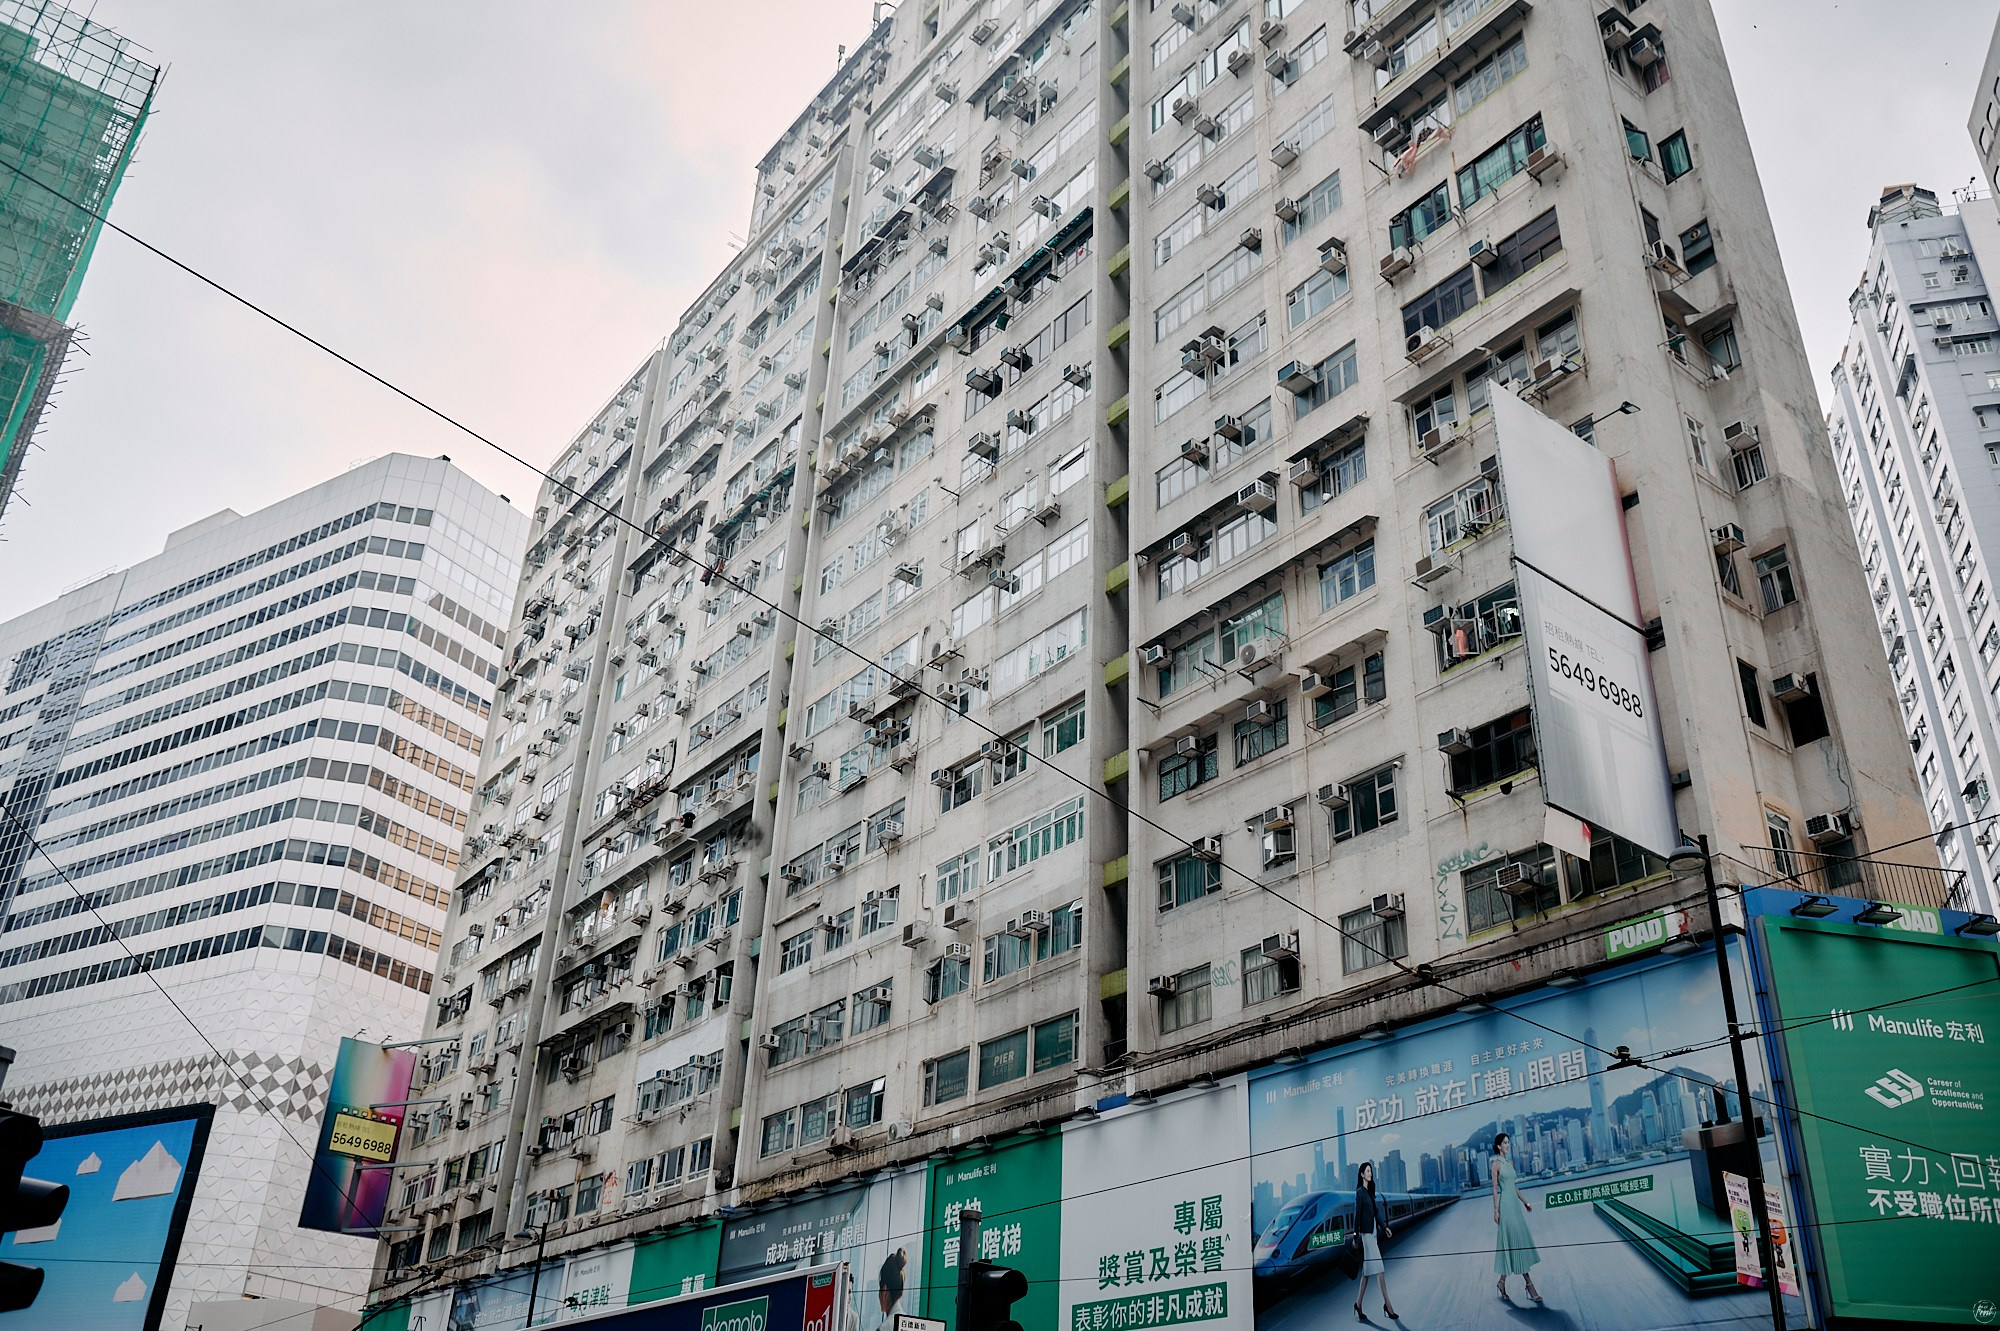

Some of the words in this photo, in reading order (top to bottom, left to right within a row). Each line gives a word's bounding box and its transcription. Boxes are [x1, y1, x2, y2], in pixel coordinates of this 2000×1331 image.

[1548, 646, 1596, 692] 5649
[1598, 675, 1643, 718] 6988
[1608, 918, 1663, 953] POAD
[1867, 1013, 1944, 1039] Manulife
[1945, 1020, 1985, 1044] 宏利
[993, 1050, 1015, 1067] PIER
[1385, 1060, 1454, 1088] 完美轉換職涯
[1470, 1037, 1545, 1067] 自主更好未來
[1283, 1078, 1322, 1099] Manulife
[1322, 1071, 1344, 1089] 宏利
[1355, 1094, 1404, 1132] 成功
[1414, 1048, 1589, 1116] 就在「轉」眼間
[1927, 1077, 1953, 1087] Career
[1954, 1080, 1961, 1088] of
[1929, 1087, 1970, 1099] Excellence
[1971, 1092, 1984, 1100] and
[1931, 1097, 1984, 1110] Opportunities
[332, 1132, 361, 1148] 5649
[363, 1139, 391, 1154] 6988
[957, 1166, 983, 1182] Manulife
[1173, 1194, 1224, 1236] 專屬
[1867, 1188, 2000, 1225] 不受職位所
[765, 1241, 788, 1266] 成功
[942, 1222, 1022, 1269] 晉階梯
[1075, 1286, 1225, 1331] 表彰你的非凡成就
